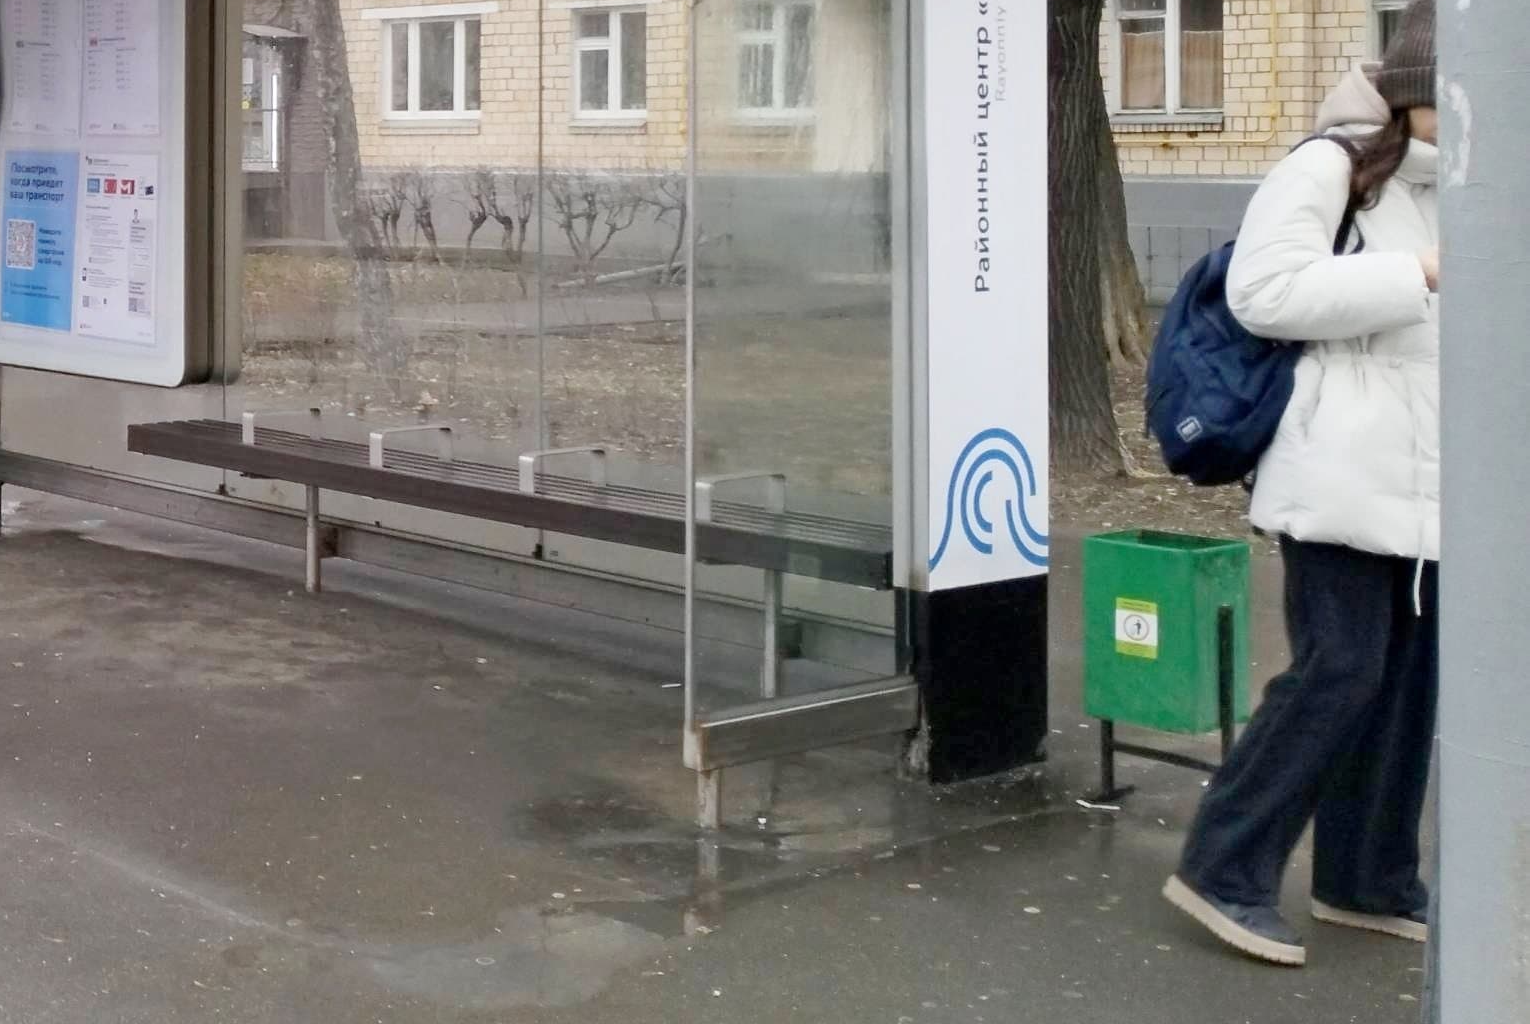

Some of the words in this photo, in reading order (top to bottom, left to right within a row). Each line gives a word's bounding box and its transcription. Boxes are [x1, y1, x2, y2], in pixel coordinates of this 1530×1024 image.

[976, 27, 992, 120] центр
[994, 6, 1009, 102] Rayonniy
[973, 131, 990, 293] Районный
